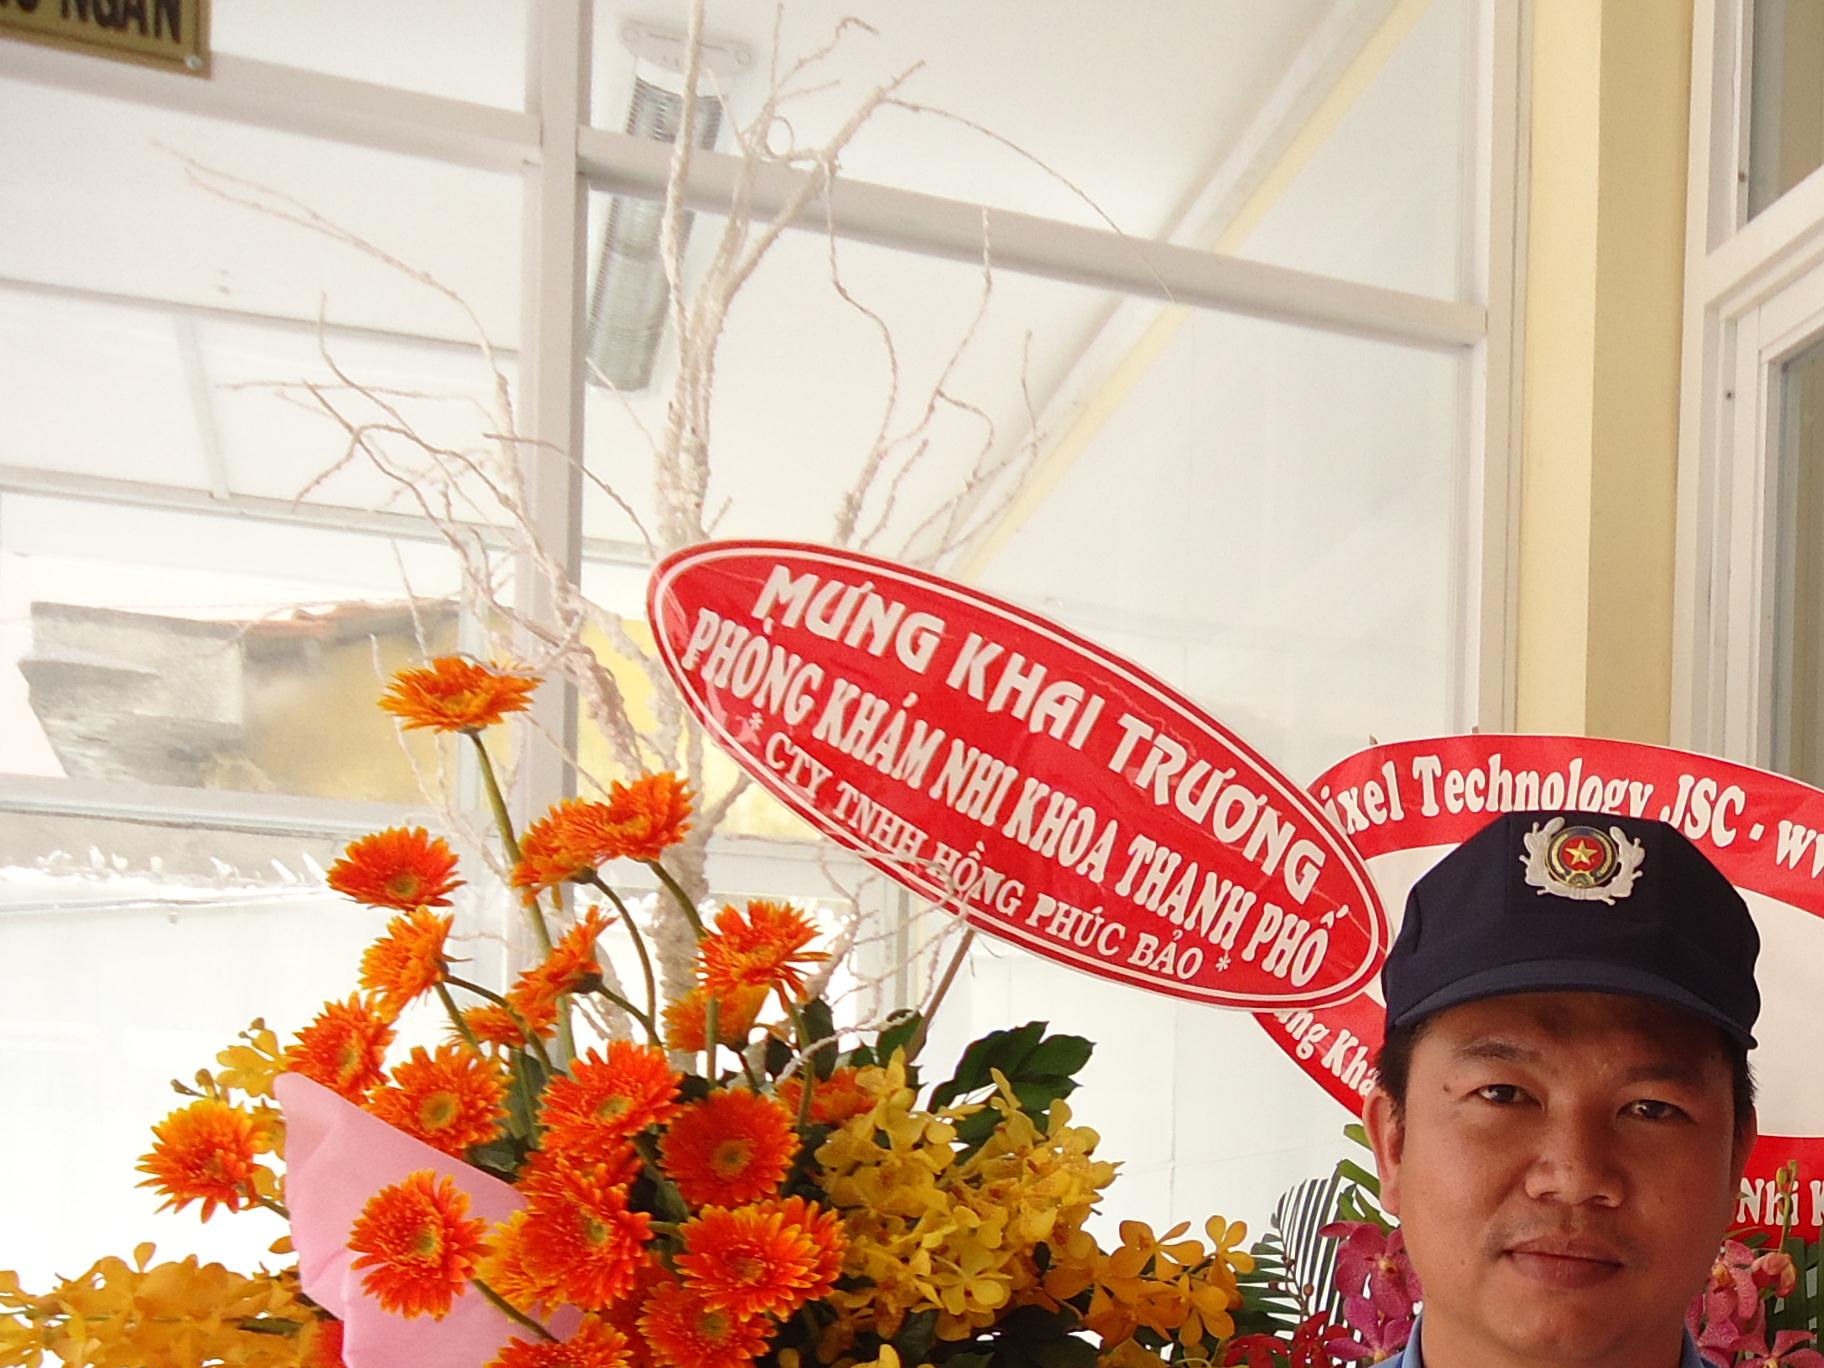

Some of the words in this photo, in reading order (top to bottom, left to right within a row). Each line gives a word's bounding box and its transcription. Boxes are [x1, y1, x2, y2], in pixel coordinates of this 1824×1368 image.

[946, 632, 1105, 750] KHAI
[765, 732, 833, 799] CTY
[833, 780, 929, 860] TNHH
[1025, 893, 1127, 956] PHÚC
[1127, 929, 1204, 980] BẢO
[813, 678, 946, 790] KHÁM
[929, 738, 1019, 827] NHI
[1002, 777, 1118, 884] KHOA
[1241, 902, 1349, 988] PHỐ
[1321, 761, 1404, 835] ixel
[1659, 774, 1745, 847] JSC
